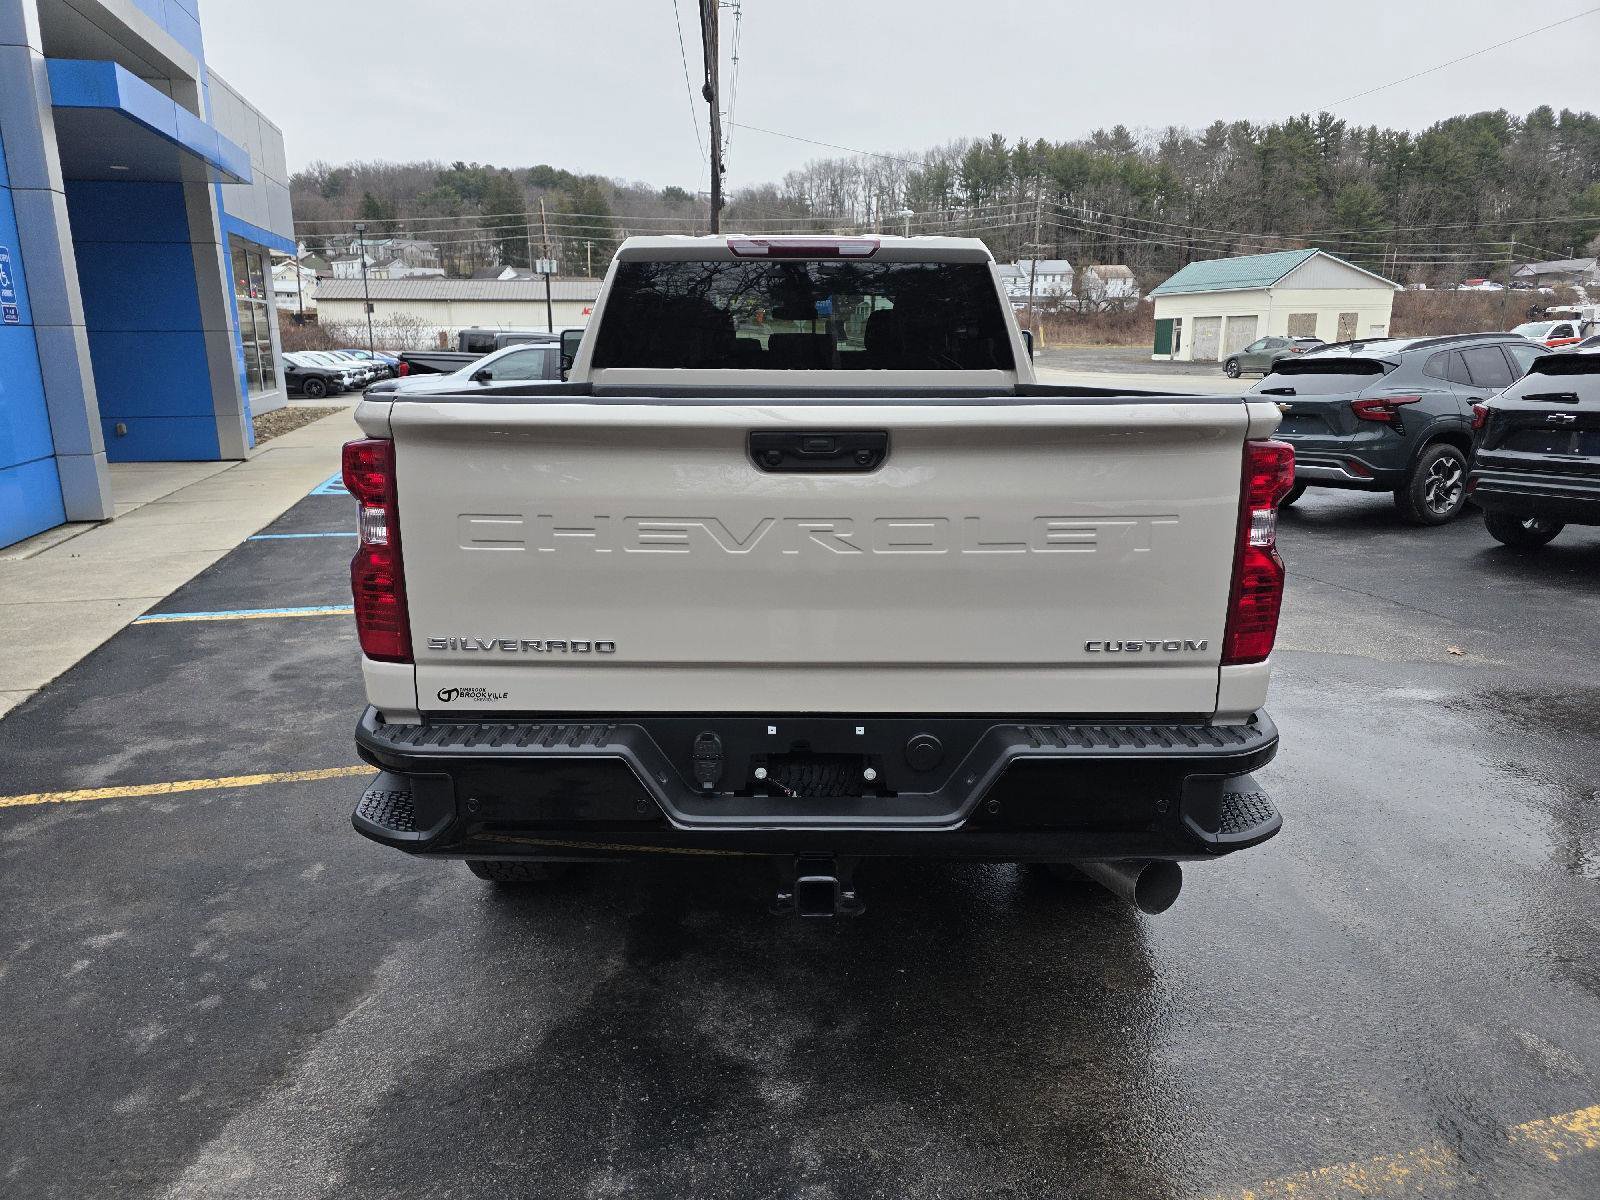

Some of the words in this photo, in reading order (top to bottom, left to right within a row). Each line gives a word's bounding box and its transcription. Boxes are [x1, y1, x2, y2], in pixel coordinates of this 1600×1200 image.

[457, 513, 1180, 556] CHEVROLET
[427, 637, 616, 652] SILVERADO
[1084, 639, 1209, 652] CUSTOM
[459, 691, 509, 700] BROOKVILLE
